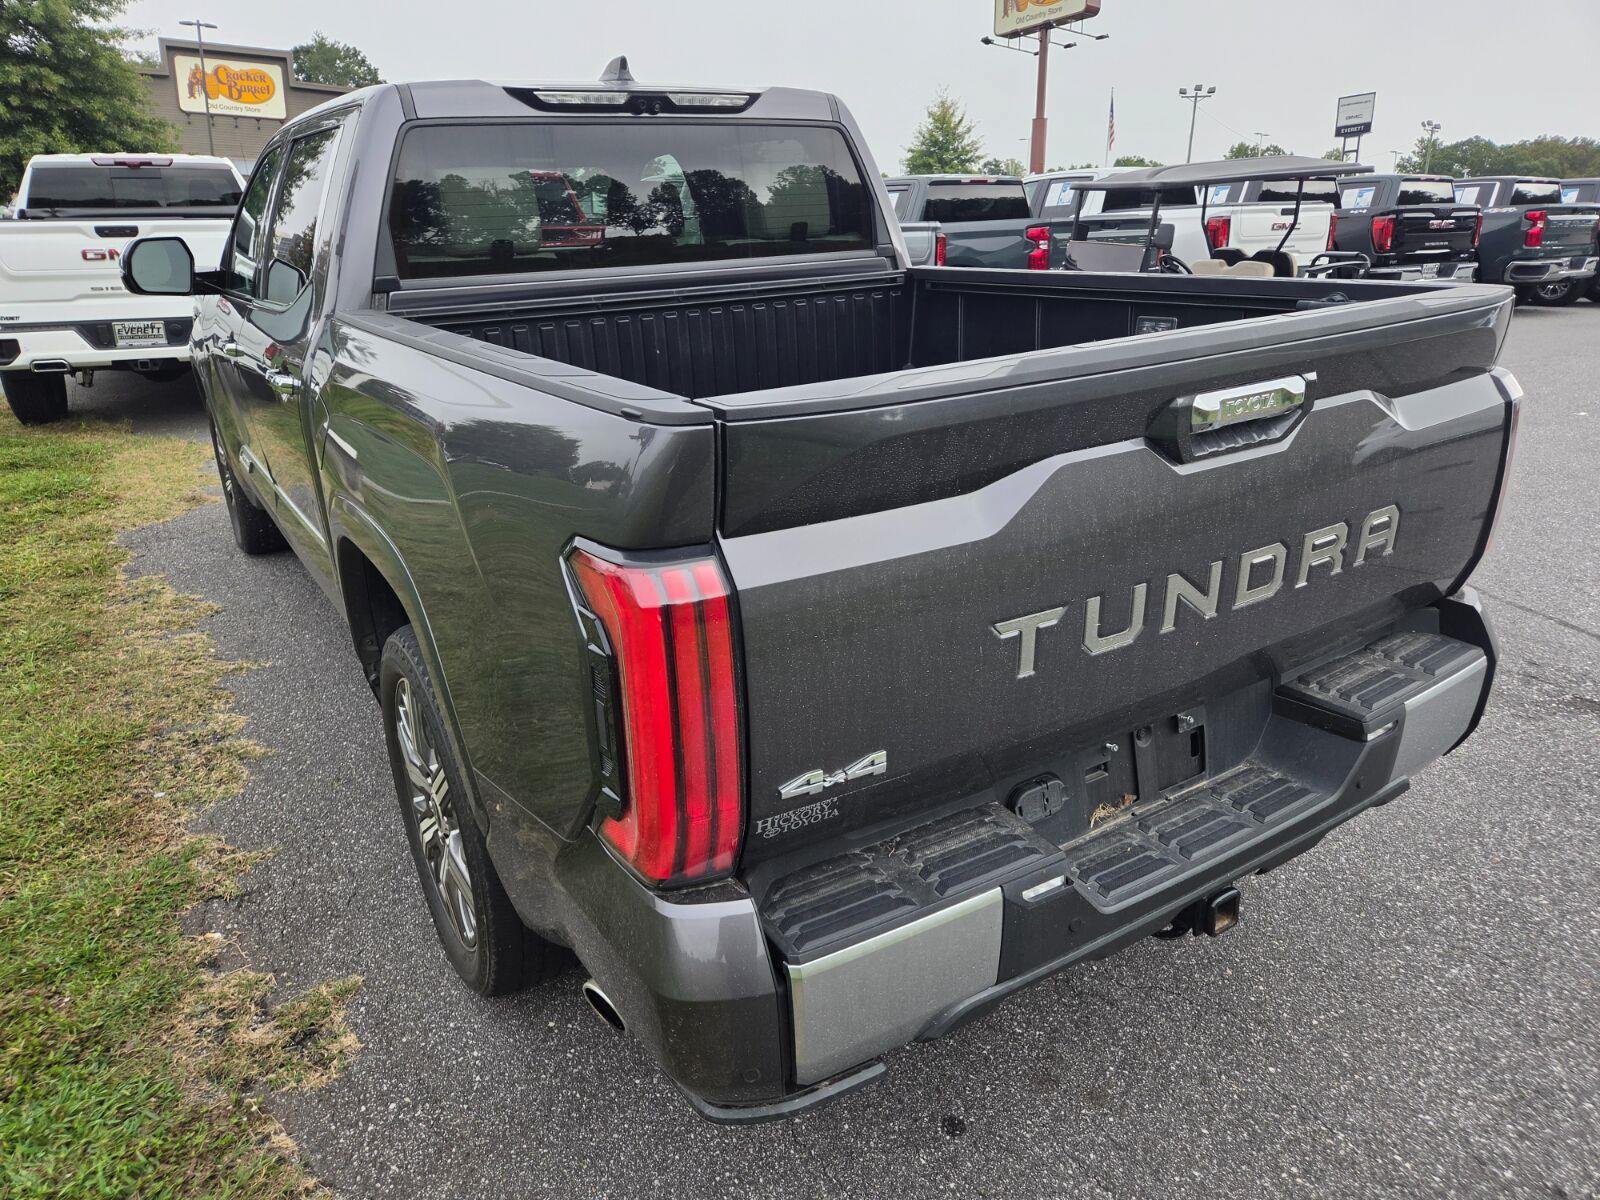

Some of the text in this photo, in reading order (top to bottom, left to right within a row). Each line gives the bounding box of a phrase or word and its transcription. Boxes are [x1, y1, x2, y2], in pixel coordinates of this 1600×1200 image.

[219, 103, 243, 113] Country
[117, 327, 162, 335] EVERETT
[1225, 392, 1277, 417] TOYOTA
[991, 504, 1400, 679] TUNDRA
[755, 801, 833, 835] HICKORY
[782, 808, 840, 833] TOYOTA
